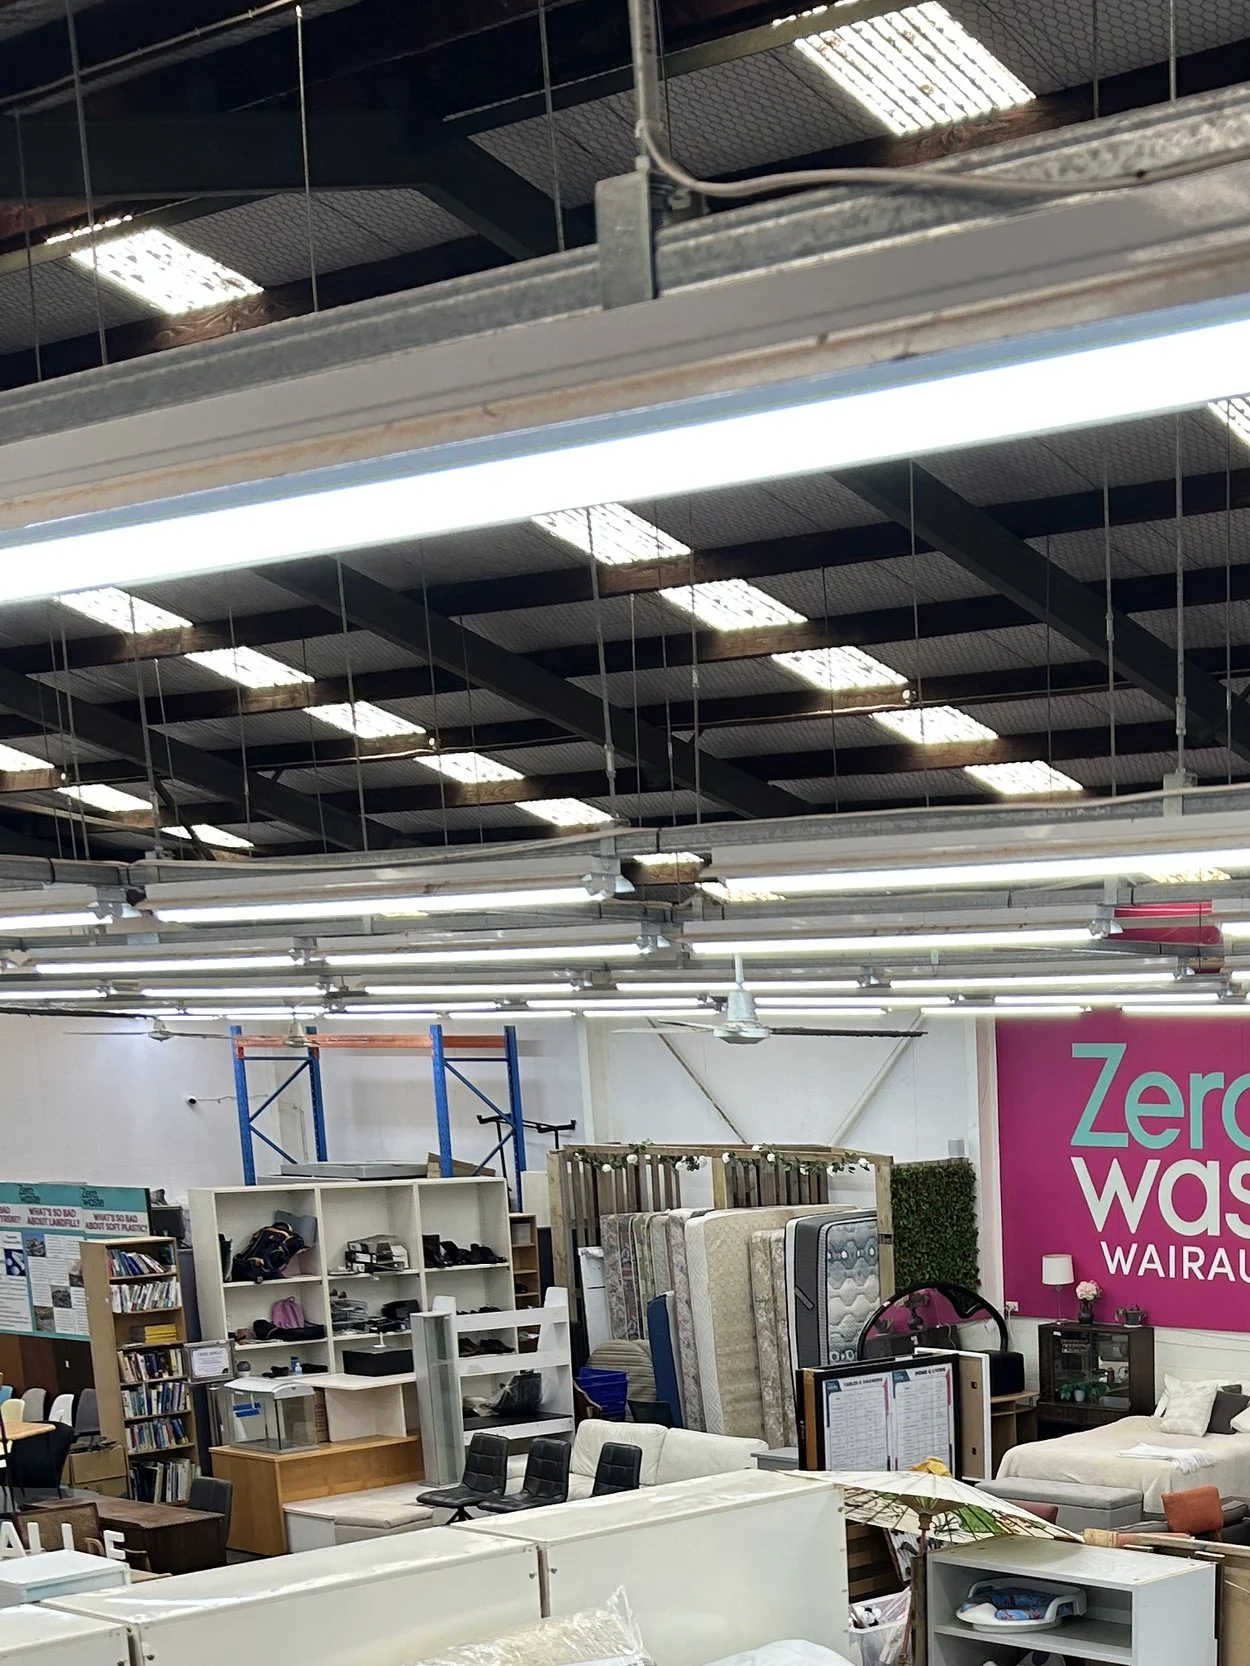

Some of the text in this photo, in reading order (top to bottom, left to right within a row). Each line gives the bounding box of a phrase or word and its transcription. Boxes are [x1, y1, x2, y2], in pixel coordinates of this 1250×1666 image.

[53, 1209, 62, 1217] SO
[63, 1209, 76, 1218] BAD
[27, 1217, 48, 1225] ABOUT
[116, 1214, 124, 1222] SO
[125, 1215, 138, 1223] BAD
[86, 1222, 104, 1230] ABOUT
[106, 1223, 120, 1231] SOFT
